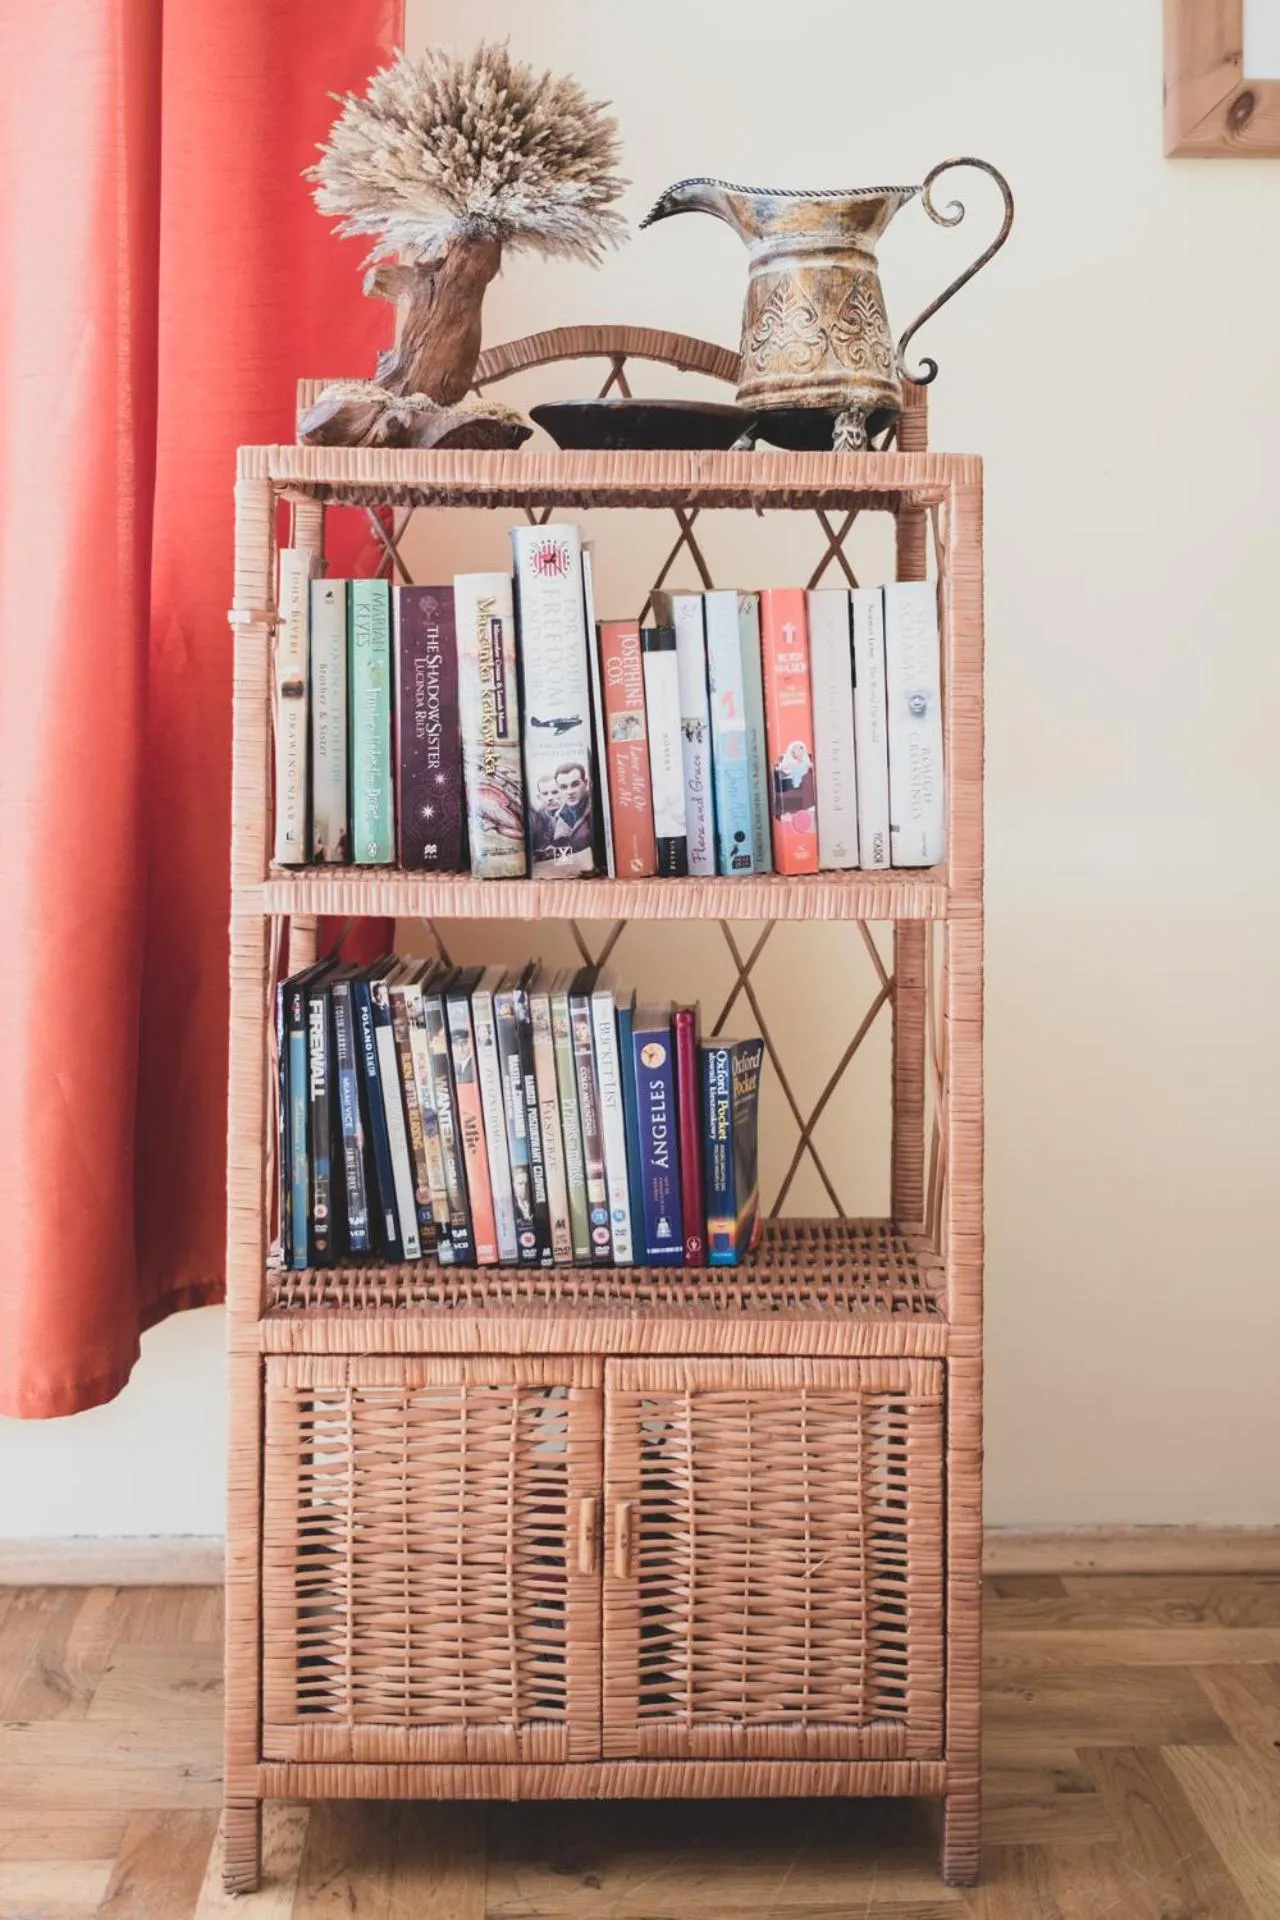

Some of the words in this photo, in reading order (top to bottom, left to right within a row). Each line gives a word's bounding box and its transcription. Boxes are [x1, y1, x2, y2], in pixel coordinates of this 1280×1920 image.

[356, 603, 372, 649] KEYES
[372, 592, 387, 653] MARIAN
[426, 624, 440, 652] THE
[900, 601, 916, 683] SCHAMA
[543, 589, 567, 707] FREEDOM
[621, 634, 645, 707] JOSEPHINE
[318, 662, 329, 706] Brother
[413, 656, 427, 707] LUCINDA
[607, 656, 624, 687] COX
[287, 712, 299, 778] DRAWING
[319, 725, 330, 758] Sister
[415, 710, 427, 739] RILEY
[687, 752, 704, 793] Grace
[831, 738, 842, 763] The
[832, 768, 845, 813] Island
[909, 732, 923, 820] CROSSINGS
[920, 746, 934, 804] ROUGH
[689, 797, 705, 823] and
[308, 999, 326, 1103] FIREWALL
[361, 1005, 374, 1051] POLAND
[599, 1020, 616, 1081] BUCKET
[579, 1065, 591, 1091] COLD
[716, 1050, 729, 1096] Oxford
[649, 1080, 671, 1169] ÁNGELES
[717, 1099, 731, 1142] Pocket
